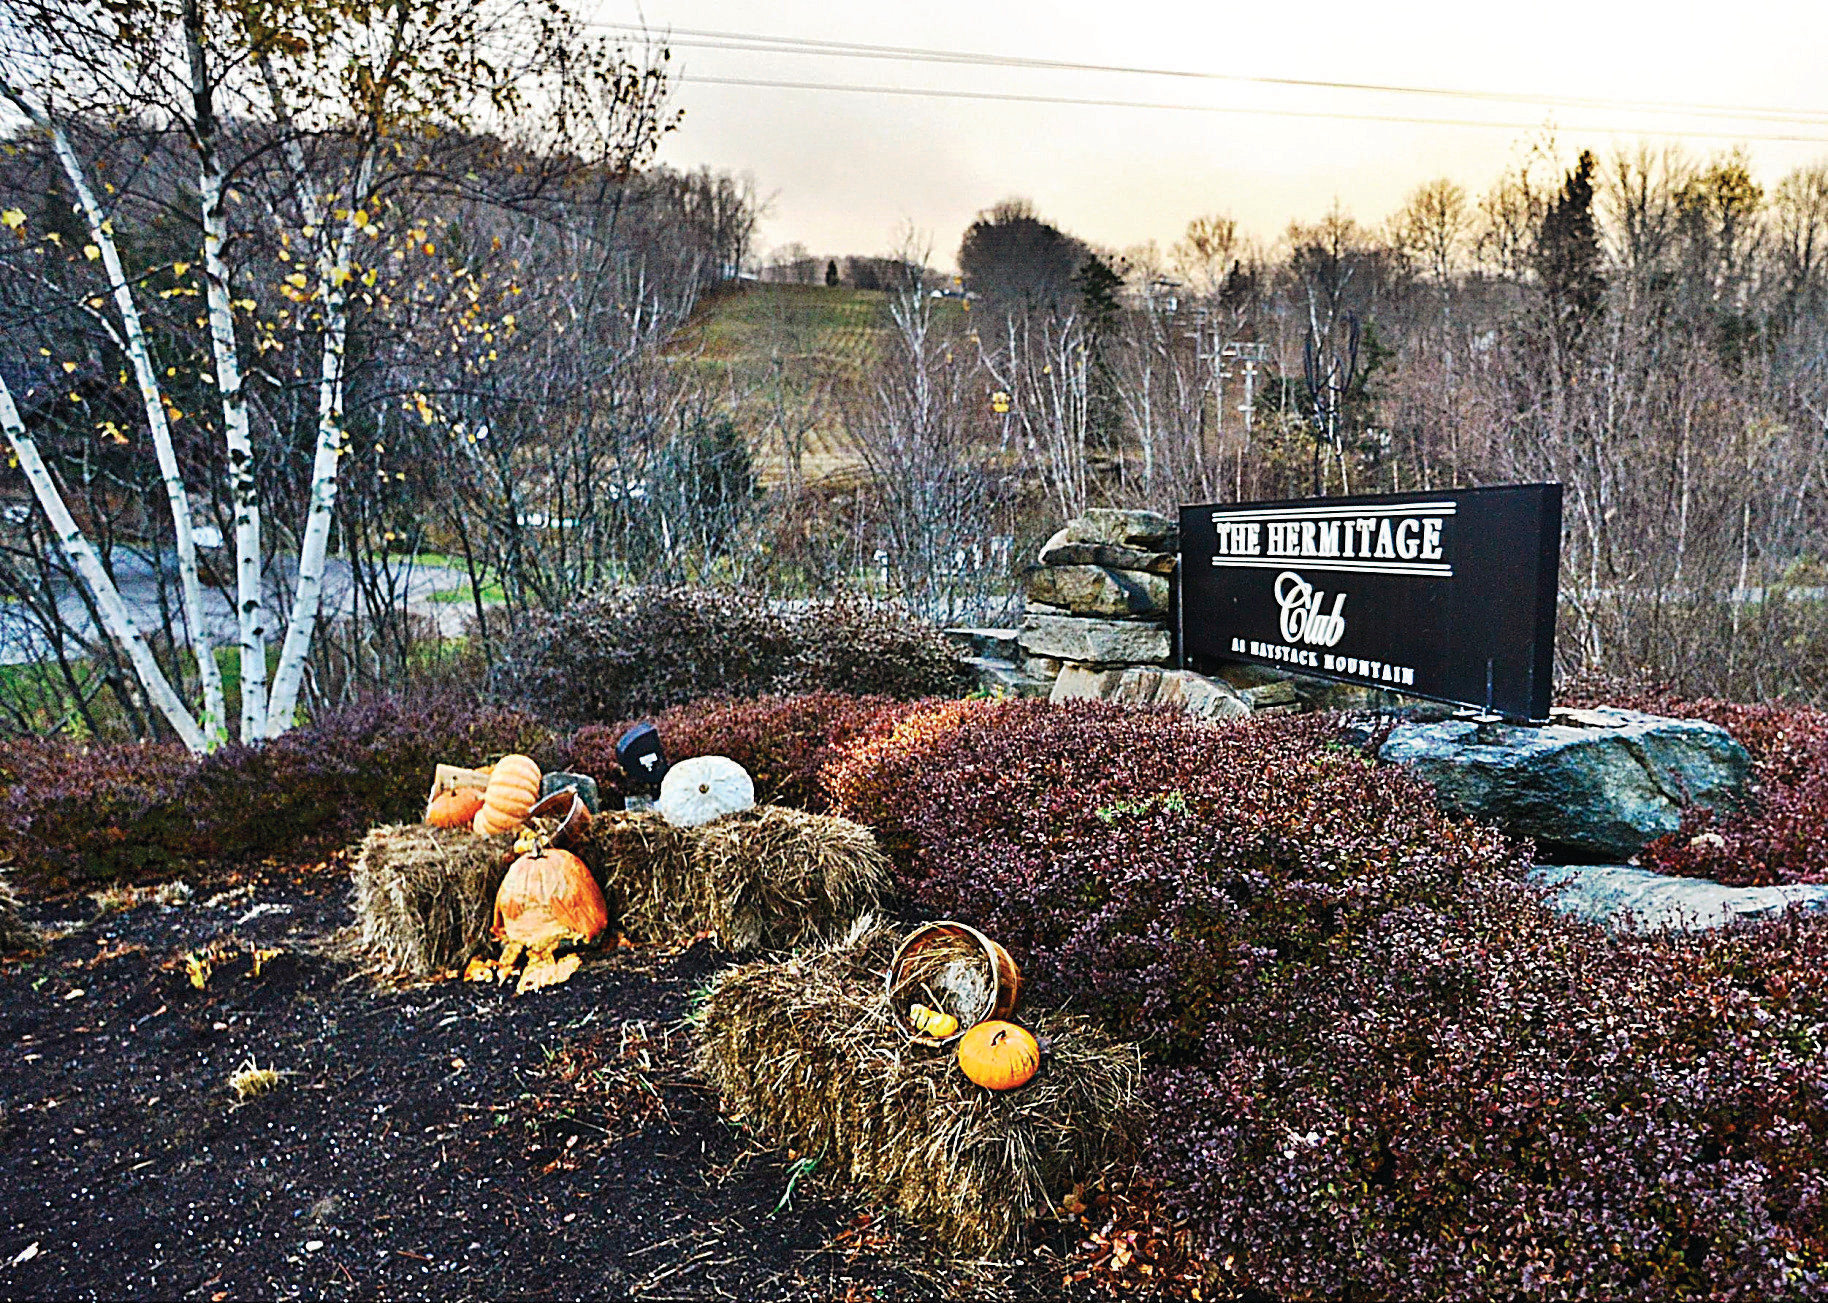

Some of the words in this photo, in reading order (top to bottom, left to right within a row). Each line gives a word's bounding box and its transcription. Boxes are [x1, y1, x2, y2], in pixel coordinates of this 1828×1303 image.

[1216, 522, 1261, 555] THE
[1266, 518, 1443, 560] HERMITAGE
[1274, 571, 1347, 648] Club
[1250, 641, 1319, 668] HAYSTACK
[1324, 654, 1415, 686] MOUNTAIN
